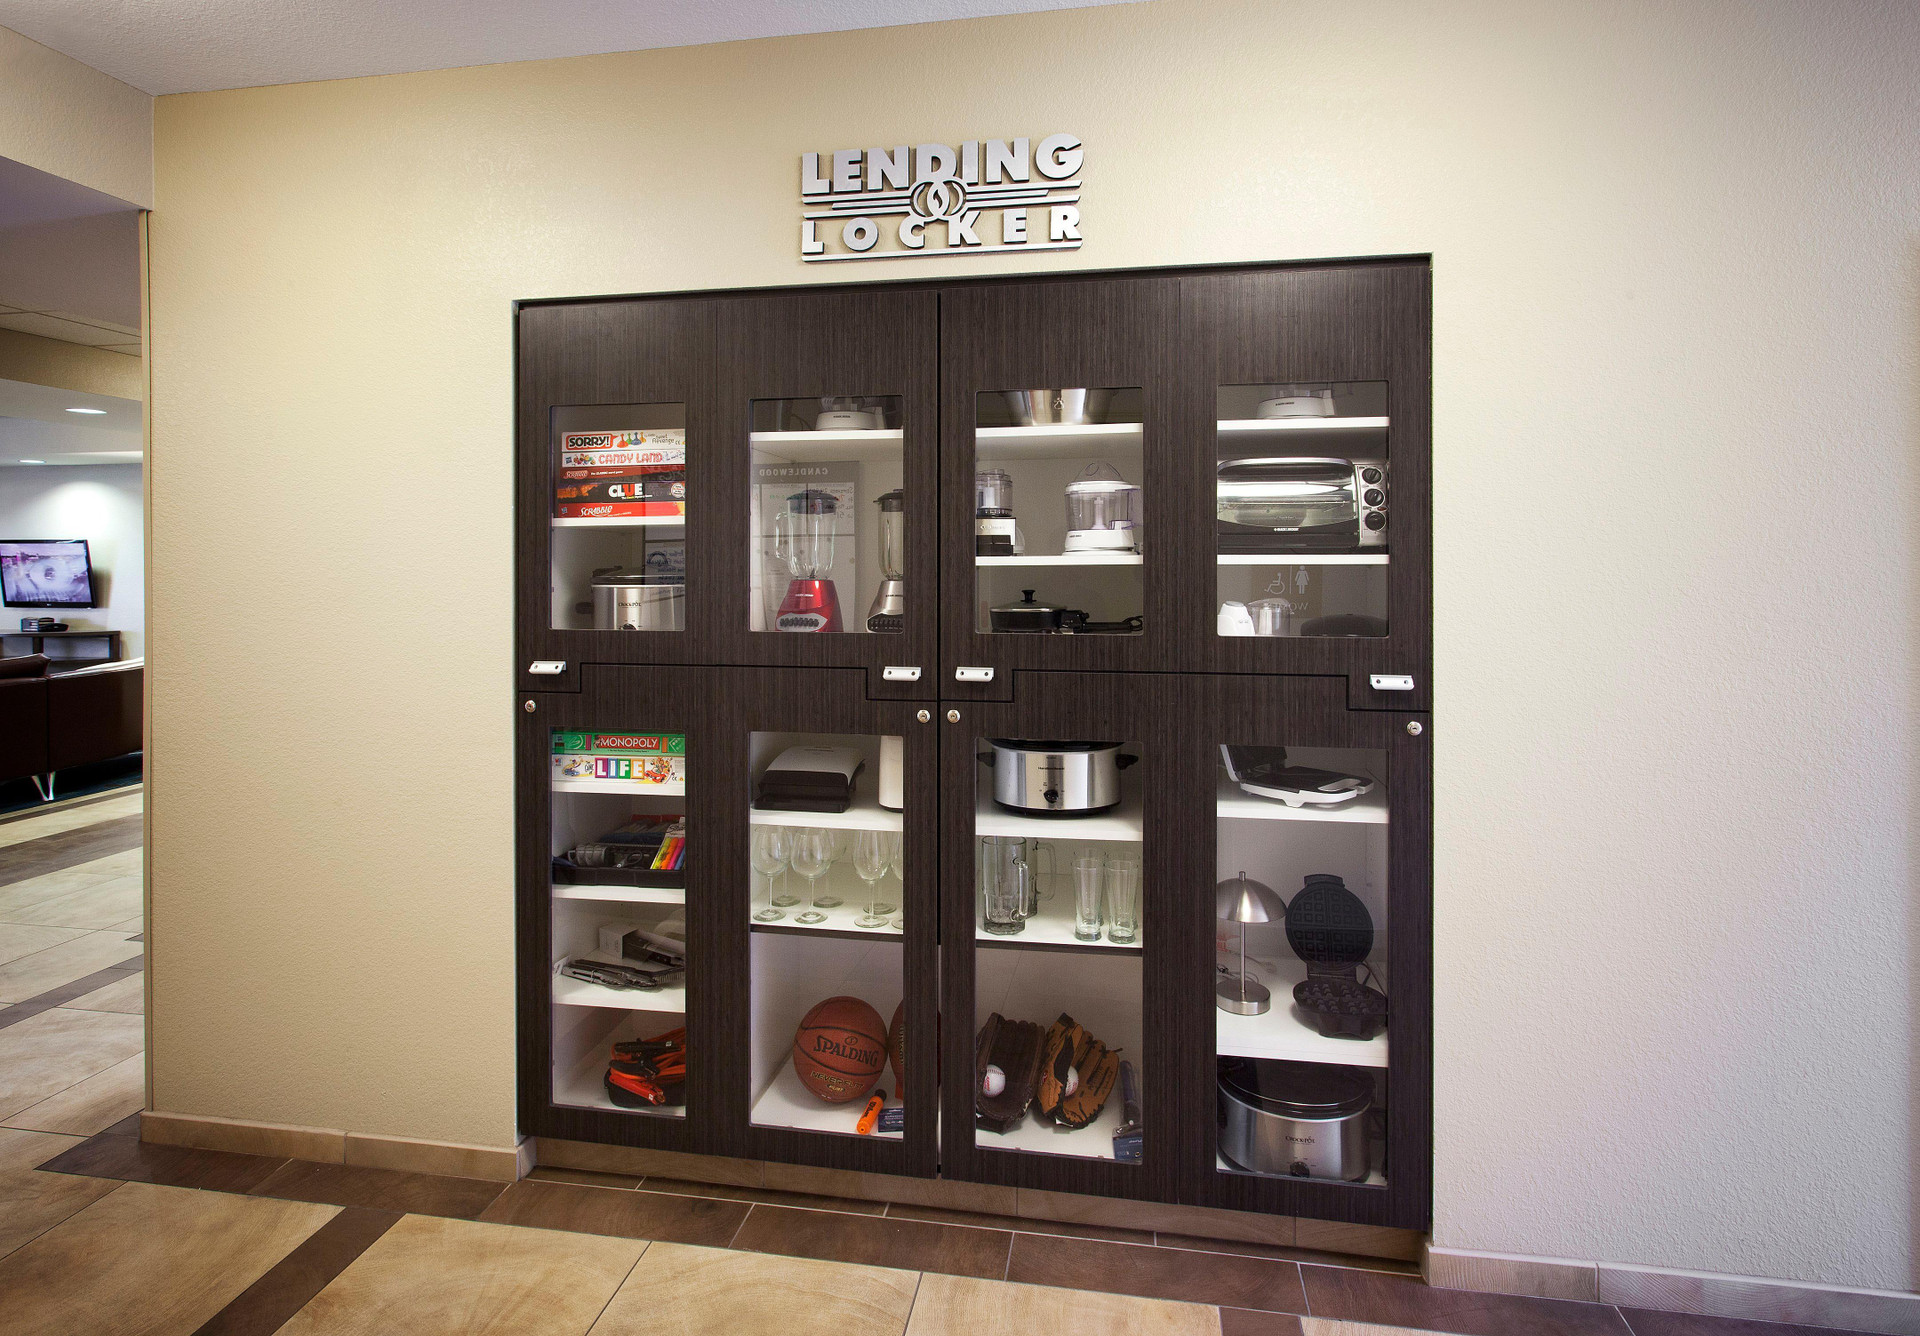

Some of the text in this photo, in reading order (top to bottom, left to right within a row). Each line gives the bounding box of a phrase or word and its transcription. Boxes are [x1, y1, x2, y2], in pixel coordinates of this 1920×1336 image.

[802, 133, 1085, 195] LENDING
[802, 205, 1083, 254] LOCKER
[568, 436, 610, 448] SORRY!
[598, 453, 634, 464] CANDY
[636, 452, 663, 463] LAND
[608, 483, 644, 498] CLUE
[580, 505, 613, 516] SCRABBLE
[600, 736, 658, 748] MONOPOLY
[596, 759, 644, 778] LIFE
[813, 1034, 879, 1068] SPALDING
